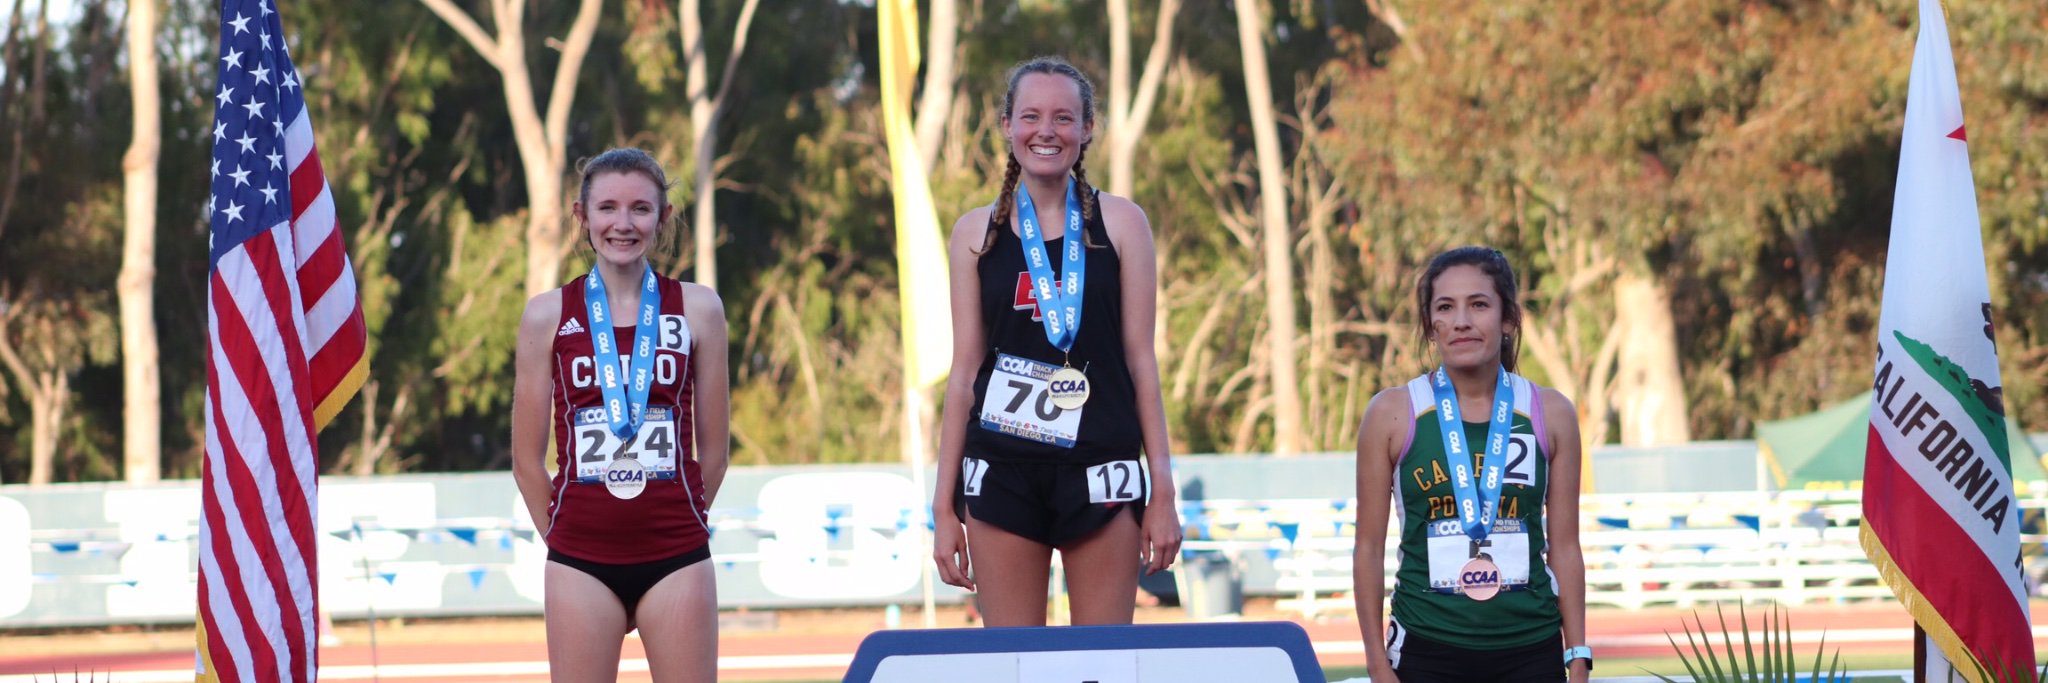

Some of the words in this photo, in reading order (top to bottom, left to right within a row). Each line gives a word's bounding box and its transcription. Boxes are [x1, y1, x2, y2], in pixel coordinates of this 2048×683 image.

[1038, 276, 1052, 300] CCAA
[1067, 272, 1078, 295] CCAA
[558, 327, 585, 336] adidas
[639, 335, 651, 357] CCAA
[598, 332, 610, 354] CCAA
[604, 364, 616, 389] CCAA
[1001, 357, 1033, 376] CCAA
[635, 368, 647, 392] CCAA
[1050, 380, 1086, 393] CCAA
[1004, 379, 1063, 422] 70
[581, 426, 673, 463] 224
[1000, 424, 1015, 435] SAN
[1016, 428, 1042, 441] DIEGO,
[1503, 437, 1529, 481] 2
[608, 469, 643, 482] CCAA
[1097, 462, 1133, 499] 12
[1456, 464, 1469, 488] CCAA
[1486, 465, 1499, 489] CCAA
[1462, 499, 1475, 523] CCAA
[1462, 570, 1498, 584] CCAA
